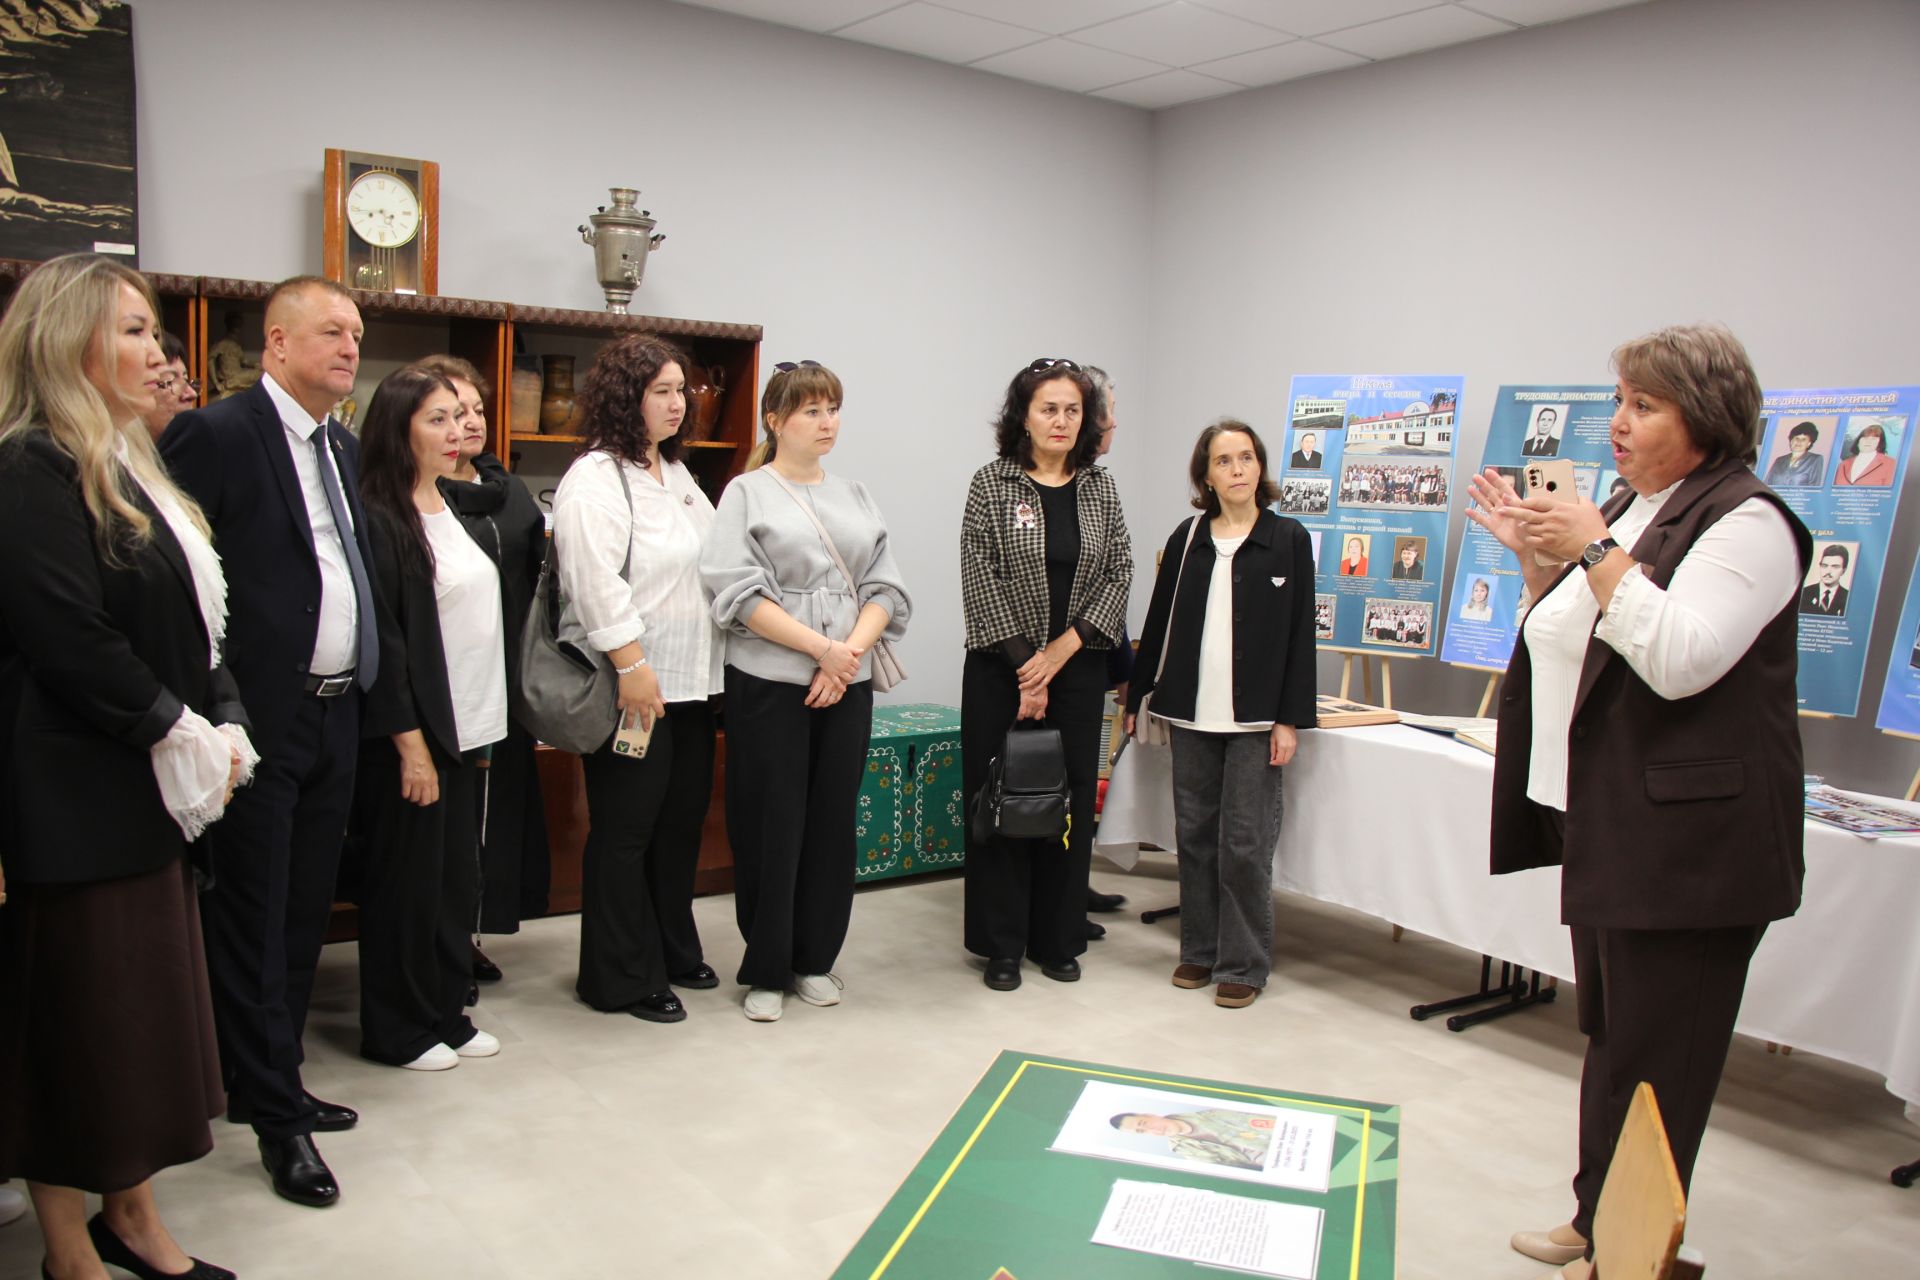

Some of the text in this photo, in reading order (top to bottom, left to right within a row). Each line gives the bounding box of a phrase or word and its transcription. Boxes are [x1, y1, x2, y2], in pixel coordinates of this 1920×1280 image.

[1514, 391, 1559, 401] ТРУДОВЫЕ
[1560, 392, 1606, 402] ДИНАСТИИ
[1780, 395, 1837, 406] ДИНАСТИИ
[1839, 393, 1897, 404] УЧИТЕЛЕЙ
